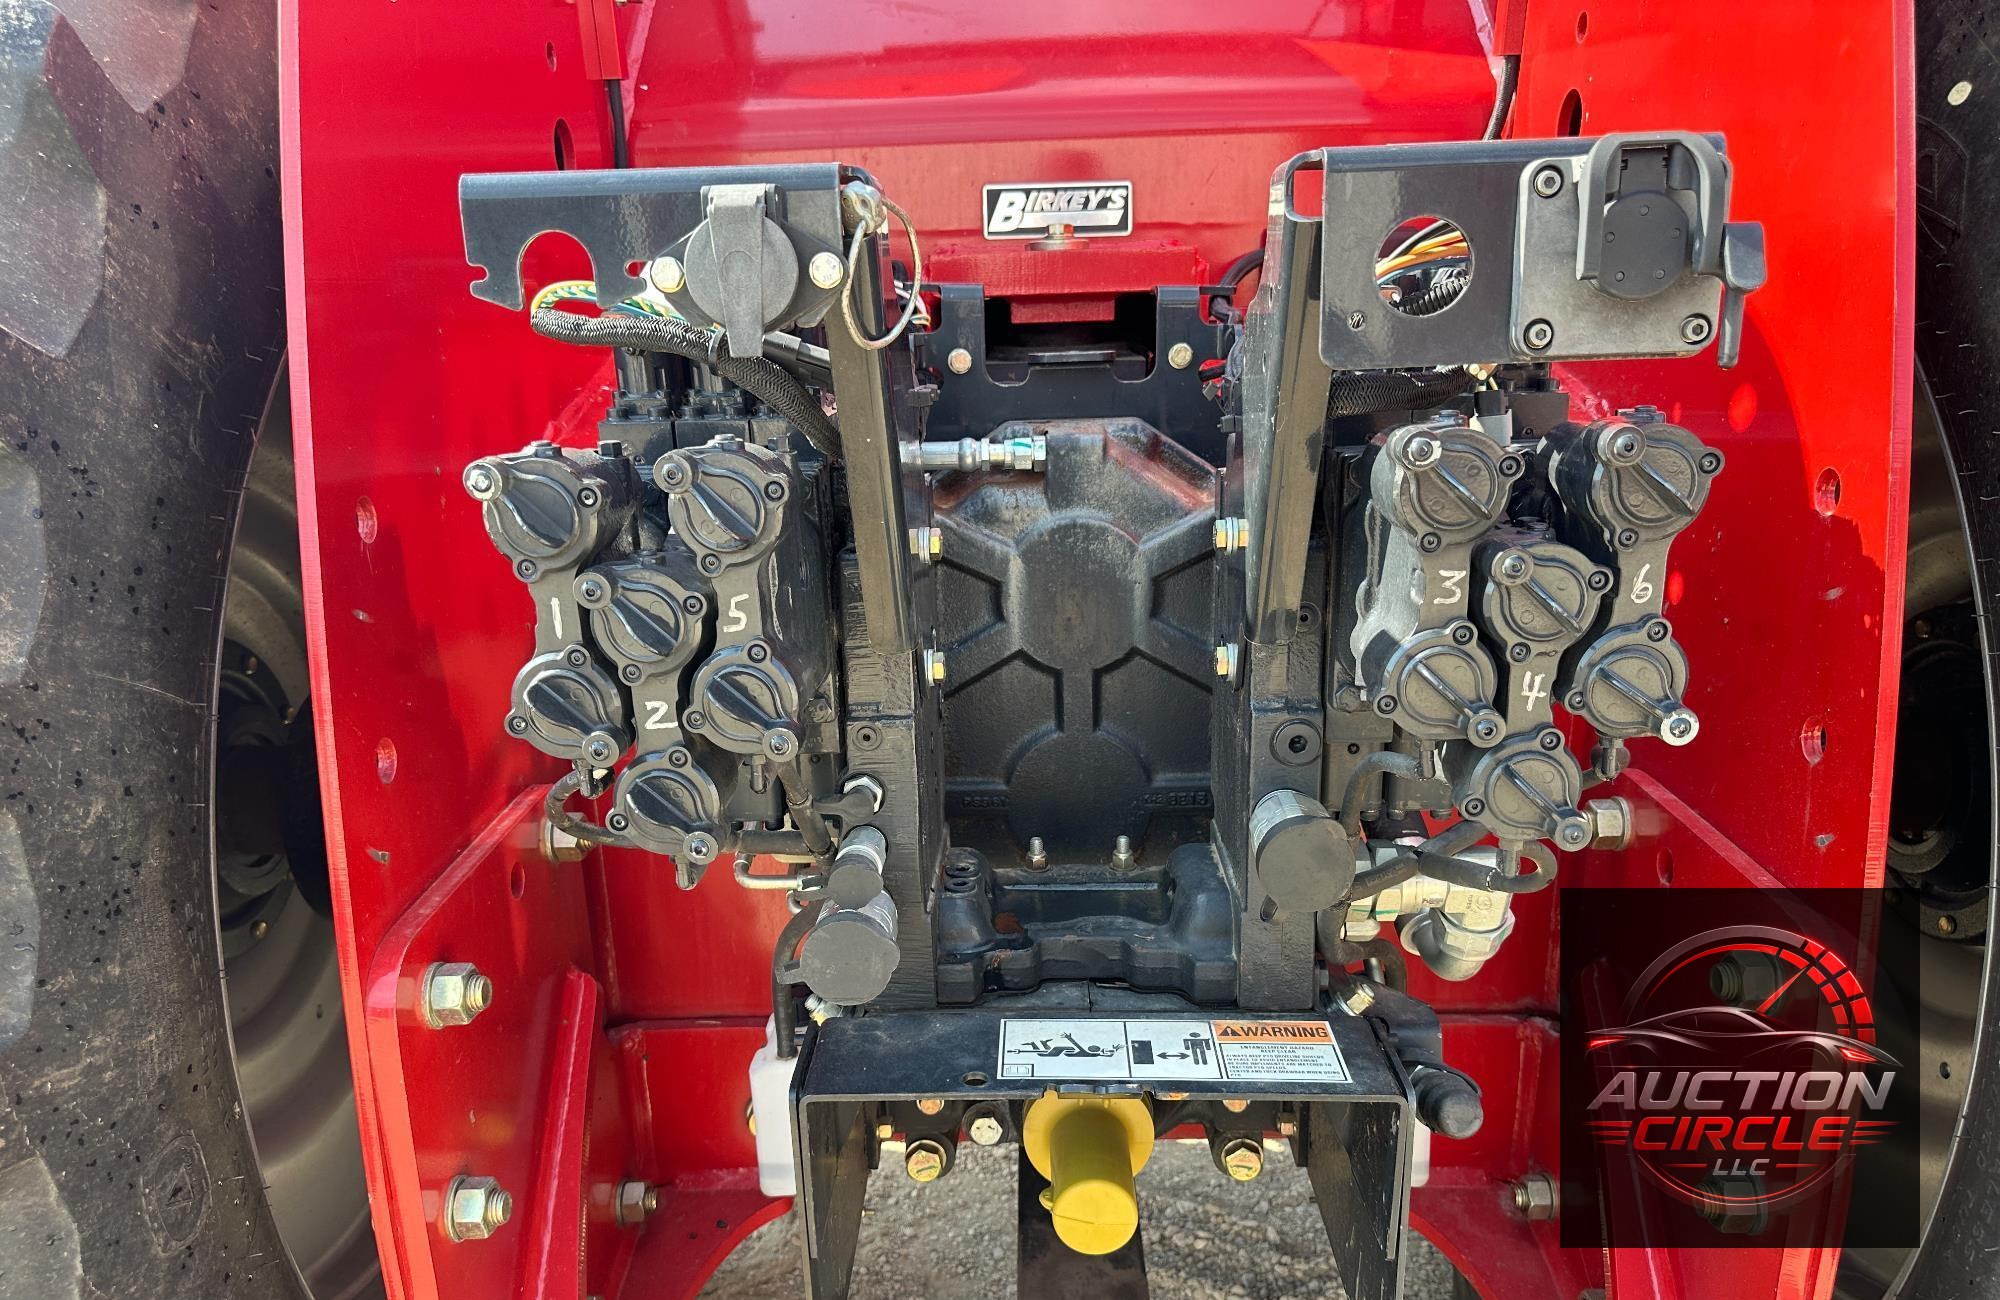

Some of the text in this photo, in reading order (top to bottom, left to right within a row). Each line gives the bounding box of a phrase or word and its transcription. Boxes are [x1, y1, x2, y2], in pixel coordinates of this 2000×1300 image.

[988, 188, 1128, 232] BIRKEY'S
[1433, 570, 1466, 604] 3
[1630, 563, 1653, 604] 6
[551, 597, 562, 639] 1
[723, 593, 749, 632] 5
[1521, 671, 1547, 711] 4
[644, 701, 678, 729] 2
[1241, 1026, 1328, 1037] WARNING
